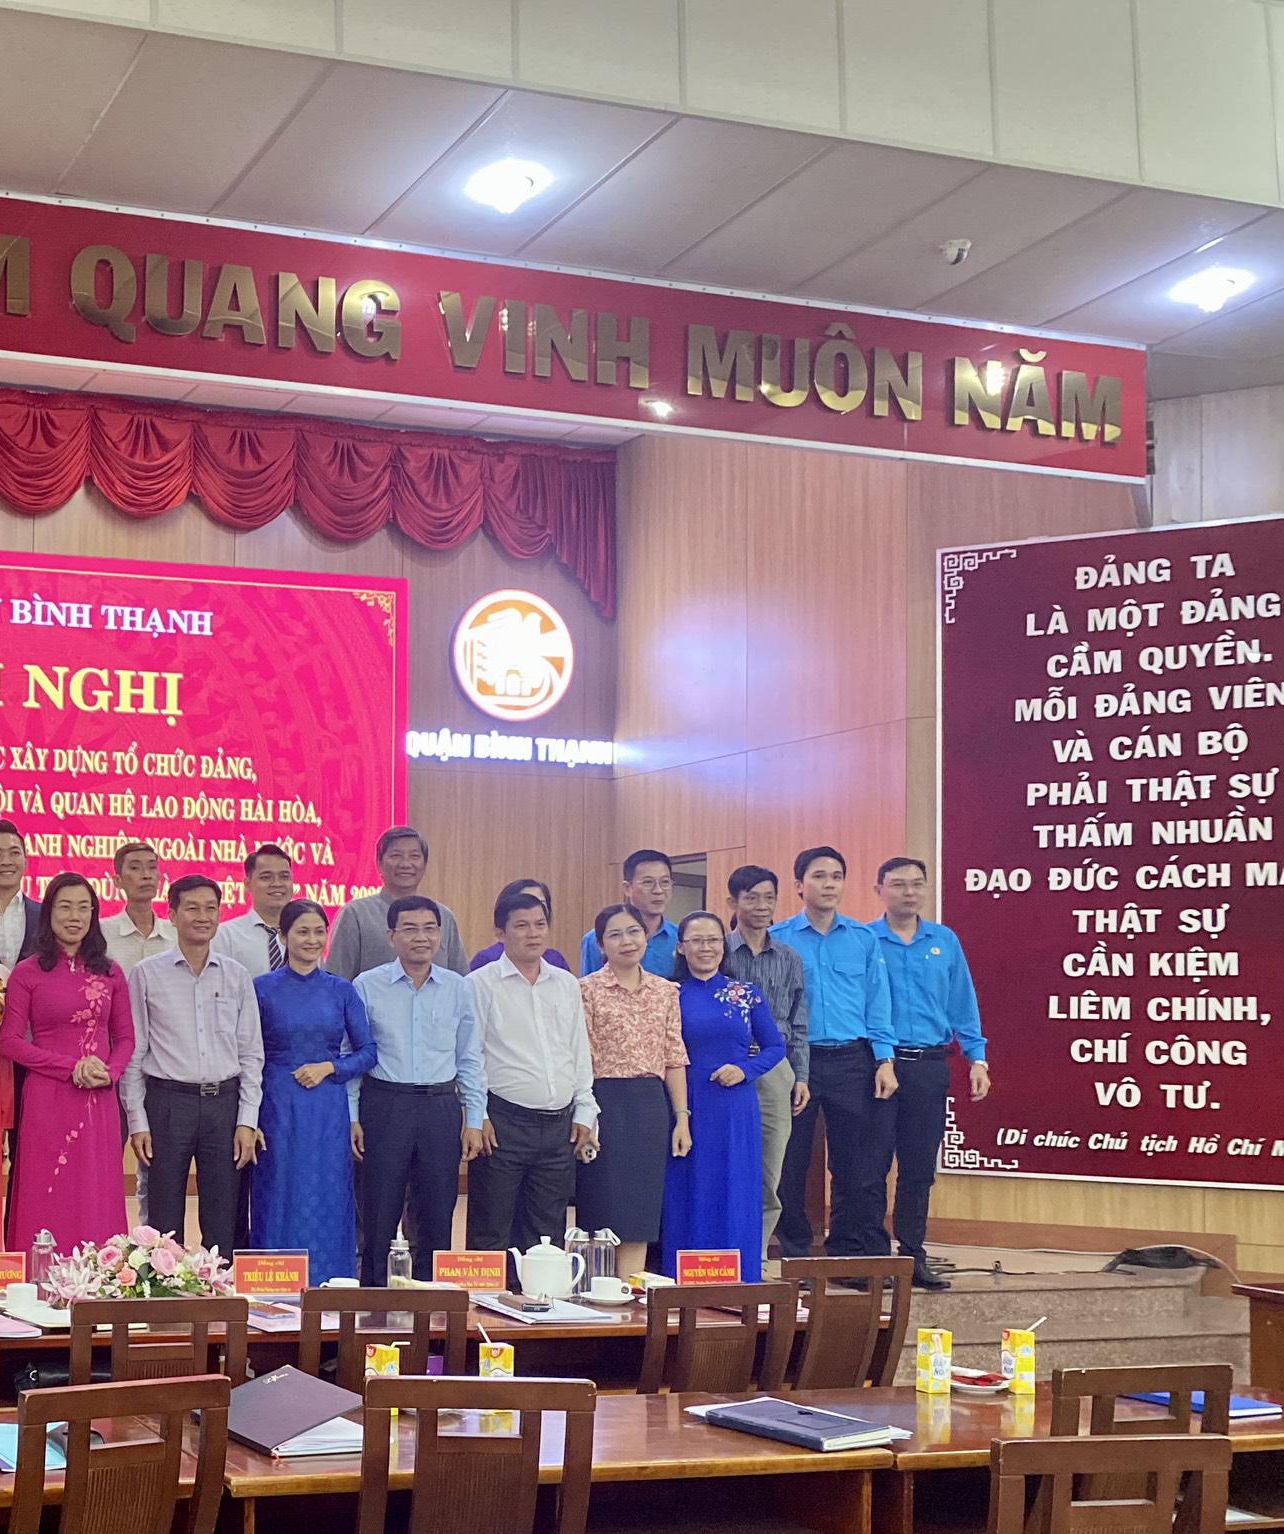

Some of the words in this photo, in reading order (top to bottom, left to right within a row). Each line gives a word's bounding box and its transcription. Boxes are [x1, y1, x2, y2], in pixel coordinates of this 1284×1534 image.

[70, 244, 402, 361] QUANG
[437, 290, 650, 390] VINH
[687, 323, 922, 421] MUÔN
[954, 348, 1122, 443] NĂM
[1075, 554, 1172, 590] ĐẢNG
[1190, 553, 1236, 580] TA
[10, 592, 92, 629] BÌNH
[100, 604, 214, 638] THẠNH
[1026, 604, 1069, 637] LÀ
[1087, 599, 1165, 637] MỘT
[1180, 588, 1282, 625] ĐẢNG
[1047, 641, 1123, 679] CẦM
[1139, 629, 1273, 676] QUYỀN.
[22, 664, 184, 727] NGHỊ
[1015, 686, 1077, 723] MỖI
[1094, 683, 1192, 718] ĐẢNG
[1208, 677, 1284, 711] VIÊN
[9, 740, 47, 772] XÂY
[54, 747, 108, 779] DỰNG
[112, 740, 139, 775] TỔ
[142, 746, 195, 777] CHỨC
[200, 747, 258, 784] ĐẢNG,
[1052, 730, 1093, 763] VÀ
[1109, 725, 1182, 761] CÁN
[1198, 722, 1249, 761] BỘ
[21, 783, 45, 814] VÀ
[50, 790, 105, 819] QUAN
[108, 788, 135, 822] HỆ
[140, 795, 178, 819] LAO
[182, 791, 235, 827] ĐỘNG
[239, 793, 274, 822] HÀI
[278, 793, 322, 827] HÒA,
[1026, 772, 1108, 806] PHẢI
[1126, 769, 1217, 807] THẬT
[1228, 767, 1280, 804] SỰ
[1033, 812, 1133, 849] THẤM
[1151, 805, 1273, 845] NHUẦN
[209, 834, 249, 862] NHÀ
[310, 836, 335, 866] VÀ
[305, 879, 346, 908] NĂM
[965, 868, 1032, 899] ĐẠO
[1048, 858, 1119, 892] ĐỨC
[1136, 855, 1232, 890] CÁCH
[1072, 902, 1162, 939] THẬT
[1178, 903, 1230, 939] SỰ
[1063, 941, 1134, 977] CẦN
[1149, 946, 1239, 982] KIỆM
[1048, 989, 1131, 1020] LIÊM
[1147, 989, 1272, 1026] CHÍNH,
[1070, 1032, 1132, 1064] CHÍ
[1145, 1034, 1248, 1066] CÔNG
[1094, 1076, 1141, 1109] VÔ
[1160, 1080, 1221, 1110] TƯ.
[996, 1128, 1027, 1146] (Di
[1033, 1129, 1081, 1149] chúc
[1088, 1132, 1128, 1151] Chủ
[1140, 1134, 1178, 1157] tịch
[1187, 1134, 1219, 1154] Hồ
[1227, 1137, 1263, 1156] Chí
